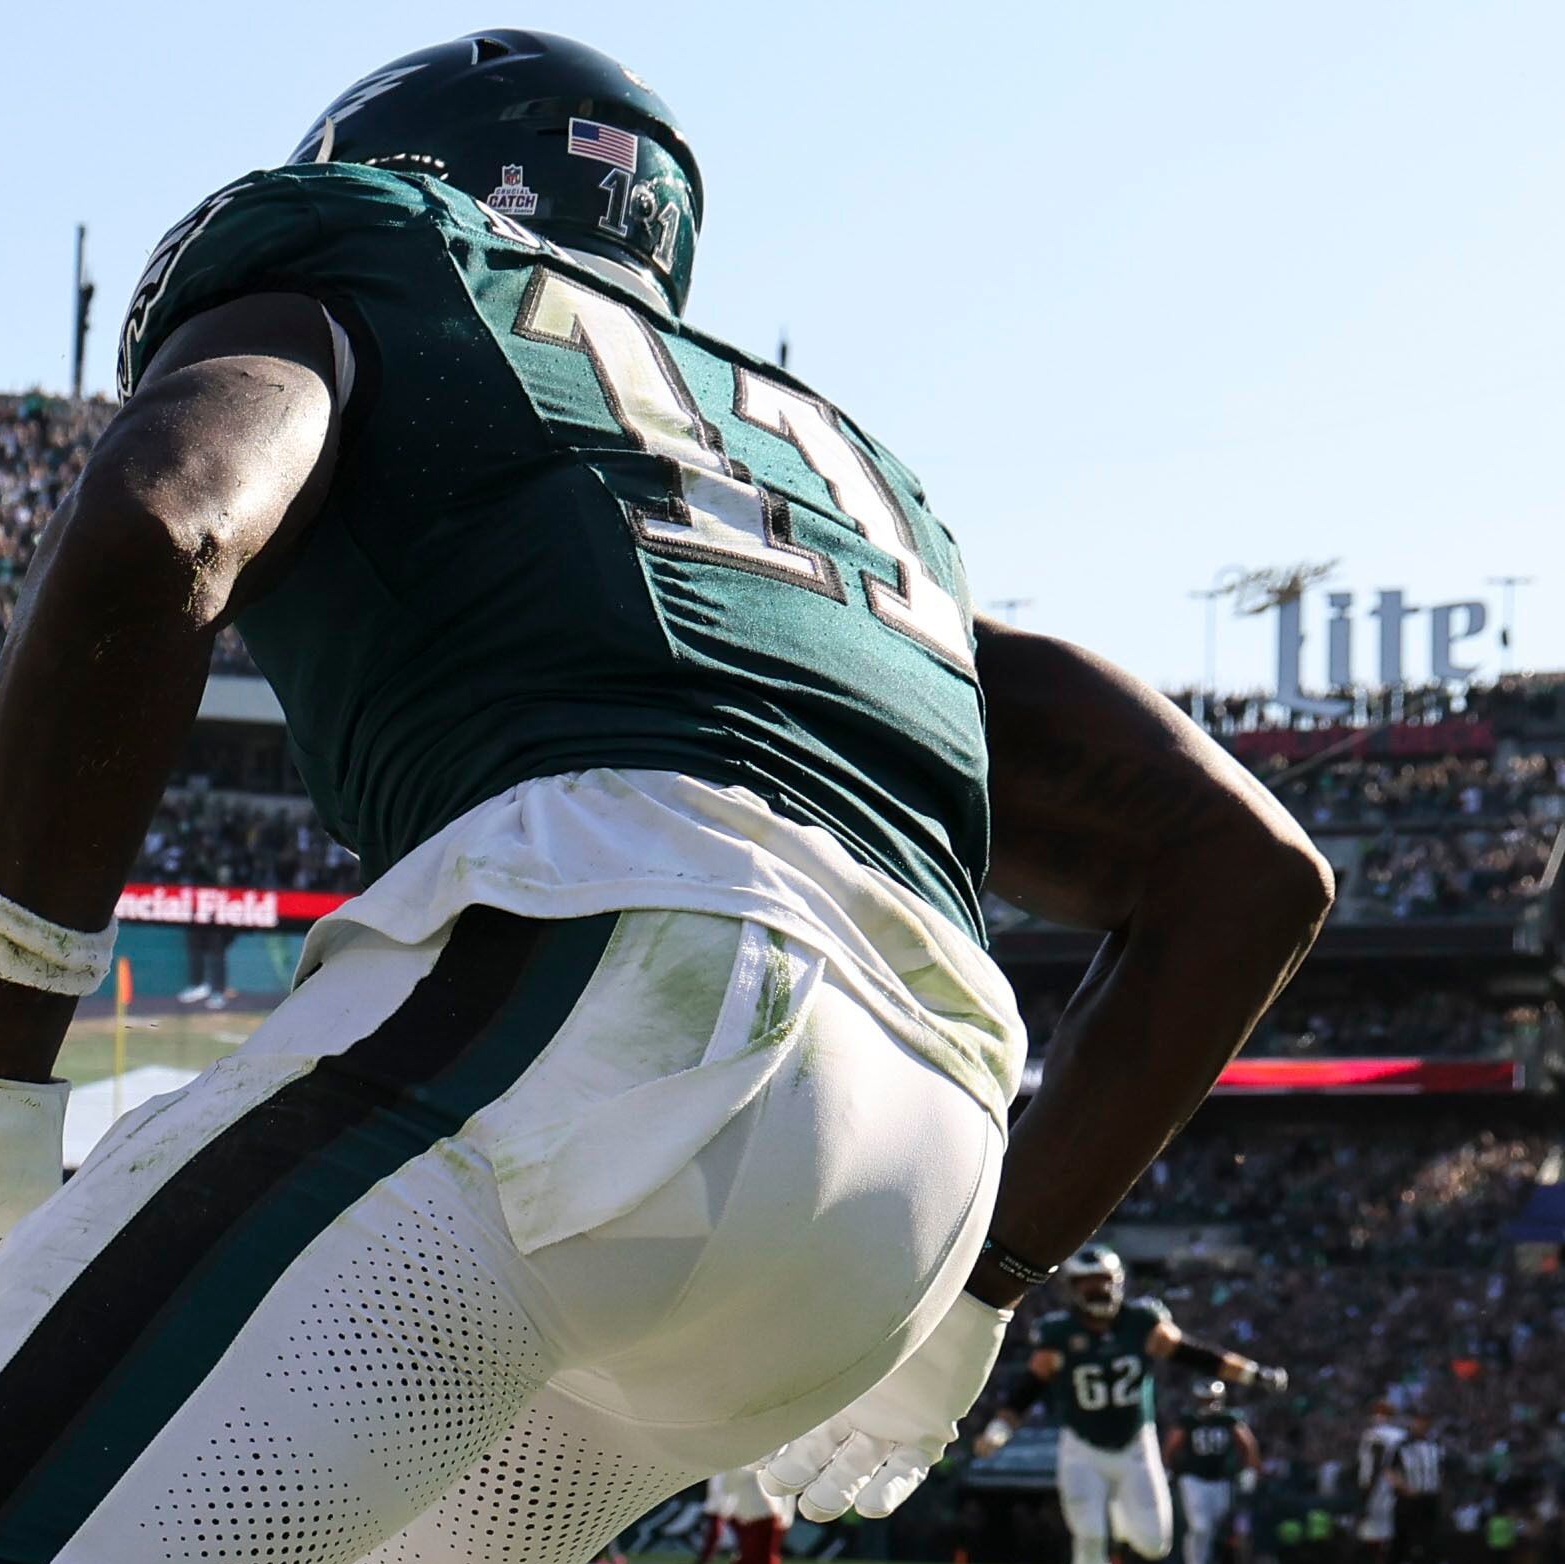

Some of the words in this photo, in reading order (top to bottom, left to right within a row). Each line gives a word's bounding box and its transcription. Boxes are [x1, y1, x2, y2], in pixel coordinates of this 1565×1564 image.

[489, 195, 536, 208] CATCH
[496, 188, 530, 196] CRUCIAL
[513, 265, 977, 678] 11
[1276, 589, 1487, 718] Lite
[115, 888, 194, 923] ncial
[196, 889, 279, 929] Field
[1072, 1355, 1143, 1412] 62
